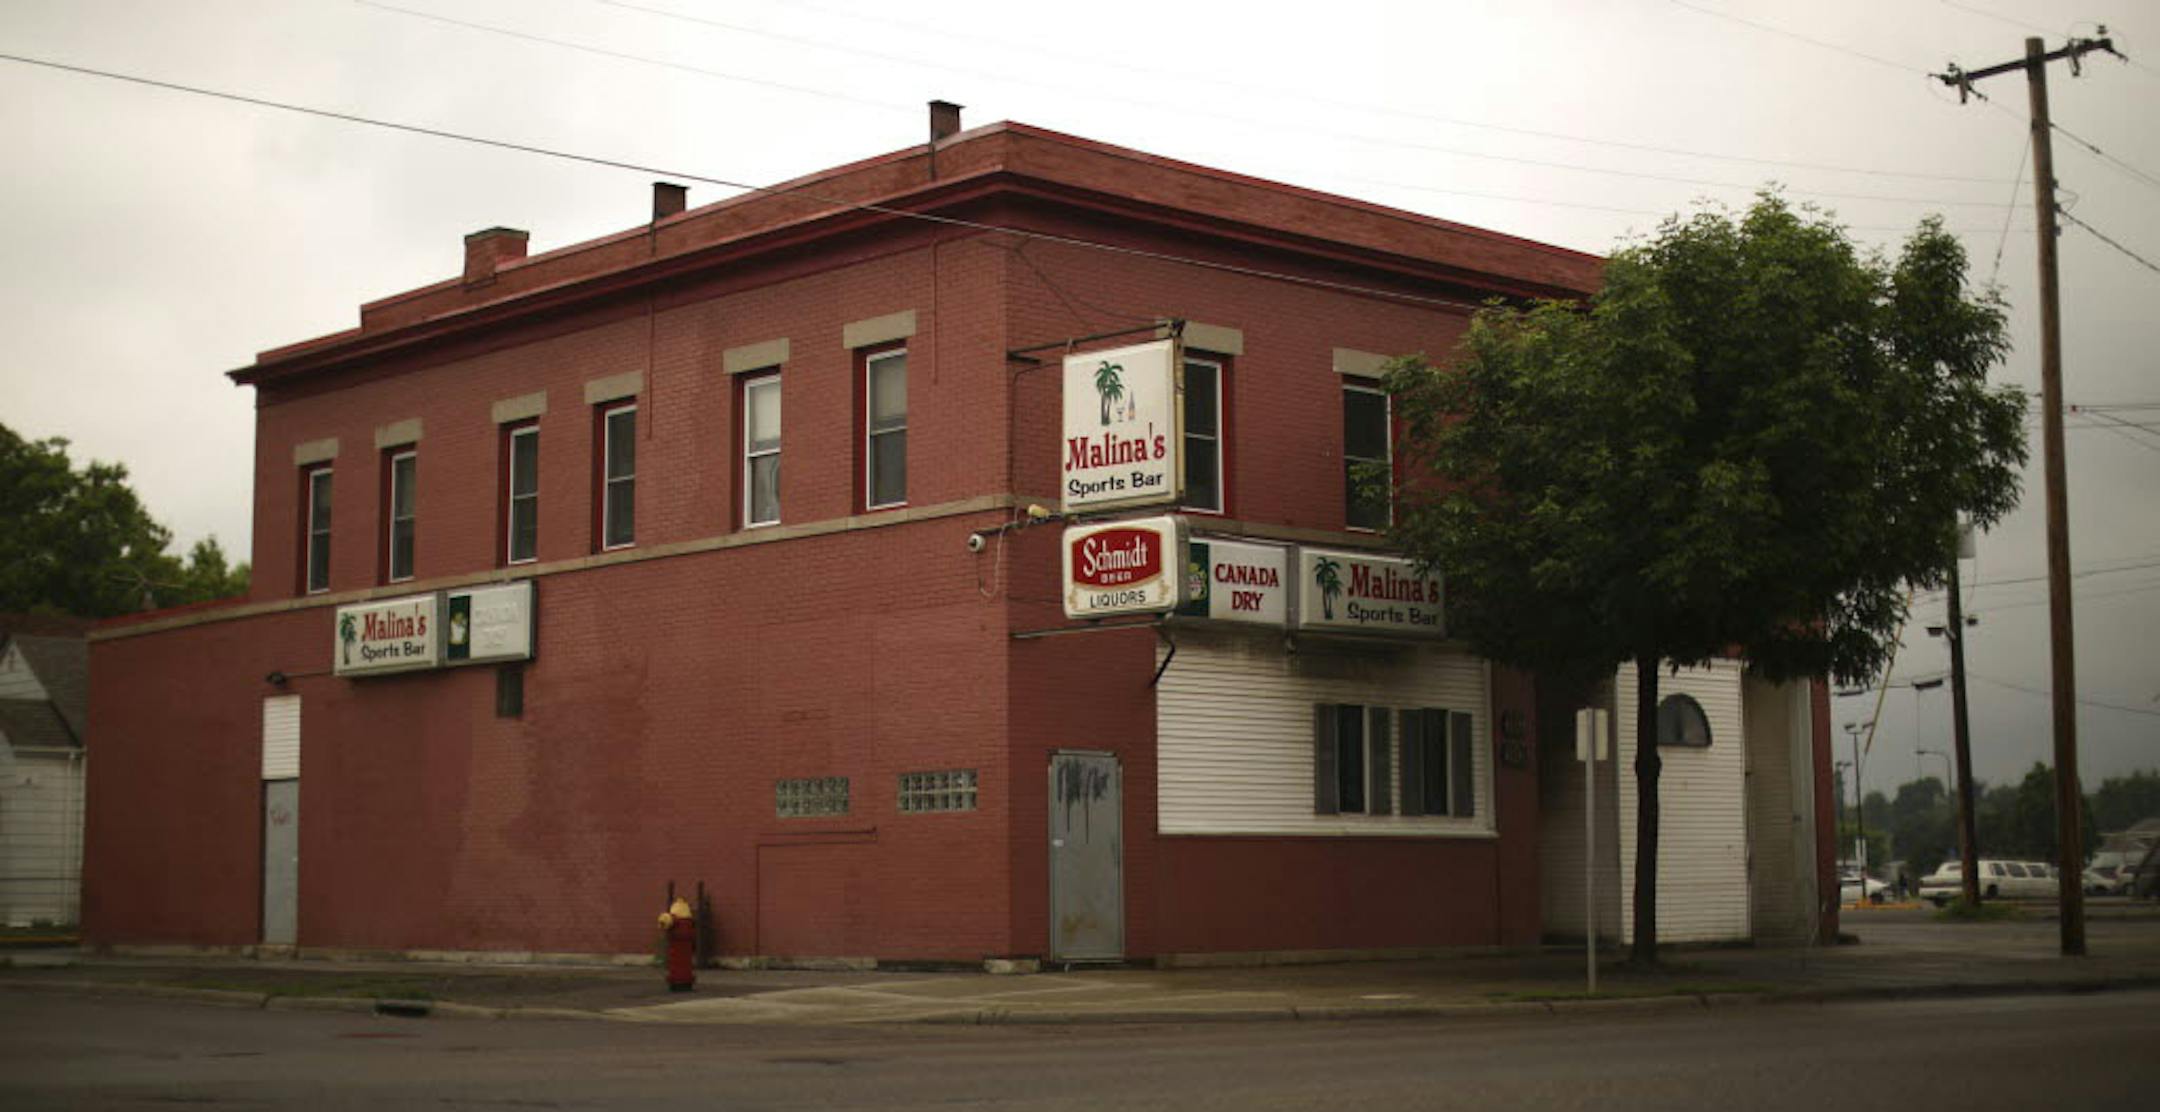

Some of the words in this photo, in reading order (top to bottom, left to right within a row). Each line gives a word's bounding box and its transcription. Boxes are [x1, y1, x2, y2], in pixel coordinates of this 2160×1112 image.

[1066, 422, 1165, 471] Malina's
[1068, 477, 1125, 498] Sports
[1131, 472, 1162, 488] Bar
[1083, 535, 1148, 577] Schmidt
[1215, 564, 1279, 588] CANADA
[1348, 563, 1439, 604] Malinas
[1090, 590, 1146, 609] LIQUORS
[1232, 591, 1264, 611] DRY
[362, 603, 427, 642] Malina's
[1348, 602, 1404, 624] Sports
[362, 642, 400, 662] Sports
[404, 641, 425, 656] Bar
